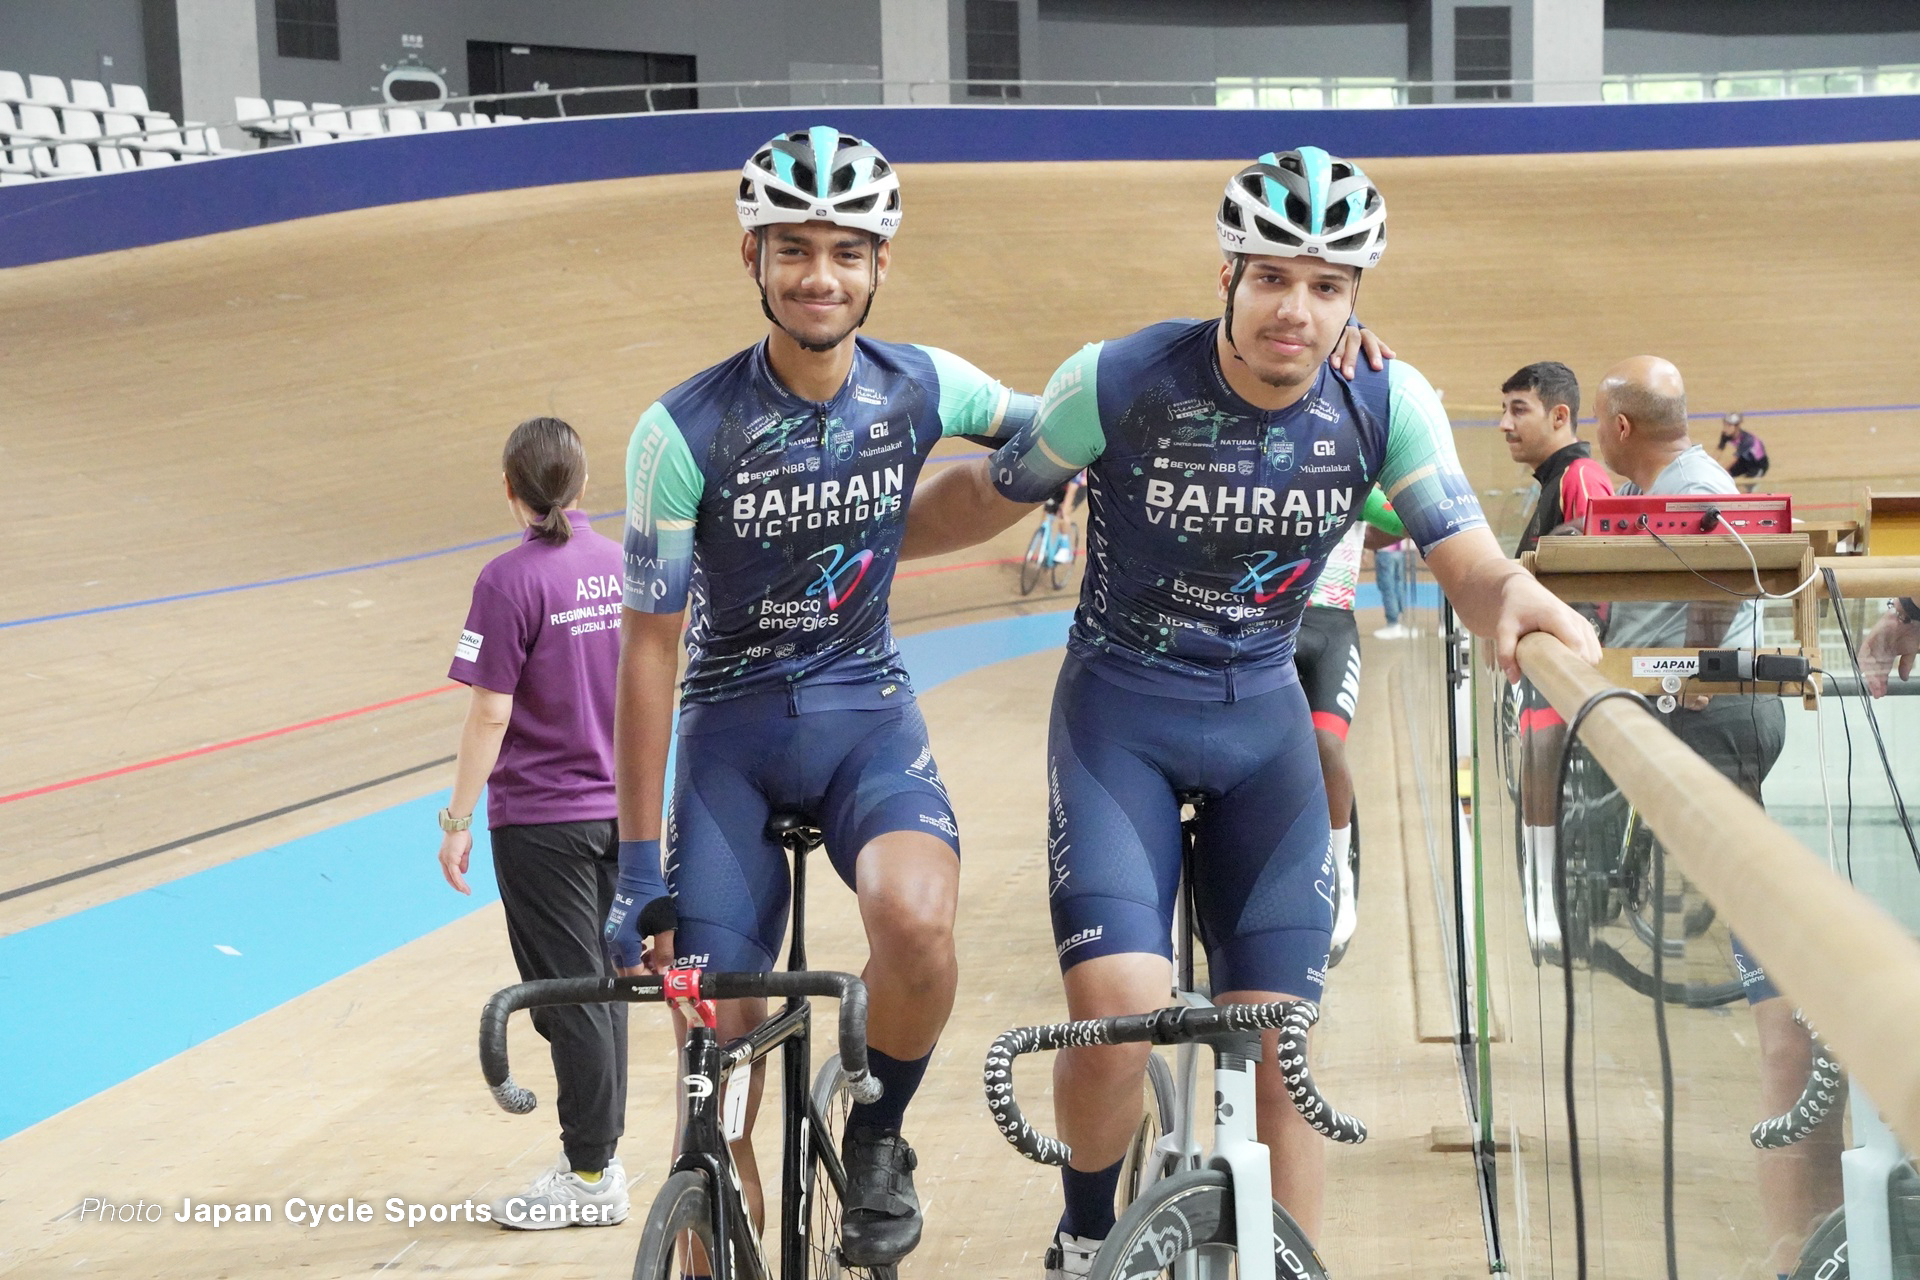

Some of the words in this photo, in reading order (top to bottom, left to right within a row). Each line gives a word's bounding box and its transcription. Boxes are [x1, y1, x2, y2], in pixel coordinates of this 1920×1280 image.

[736, 204, 759, 217] UDY
[880, 217, 900, 228] RUD
[750, 469, 779, 481] BEYON
[782, 463, 806, 475] NBB
[1170, 461, 1206, 471] BEYON
[1208, 463, 1236, 473] NBB
[631, 422, 664, 534] Bianchi
[733, 464, 904, 520] BAHRAIN
[1145, 479, 1353, 518] BAHRAIN
[734, 495, 902, 538] VICTORIOUS
[1145, 506, 1349, 537] VICTORIOUS
[624, 551, 667, 570] NIYAT
[576, 574, 622, 601] ASIA
[1173, 579, 1245, 603] Bapco
[598, 603, 622, 615] SATE
[760, 599, 820, 617] Bapco
[607, 619, 622, 629] JAP
[759, 613, 839, 632] energies
[1652, 660, 1696, 669] JAPAN
[1051, 766, 1068, 829] BUSINESS
